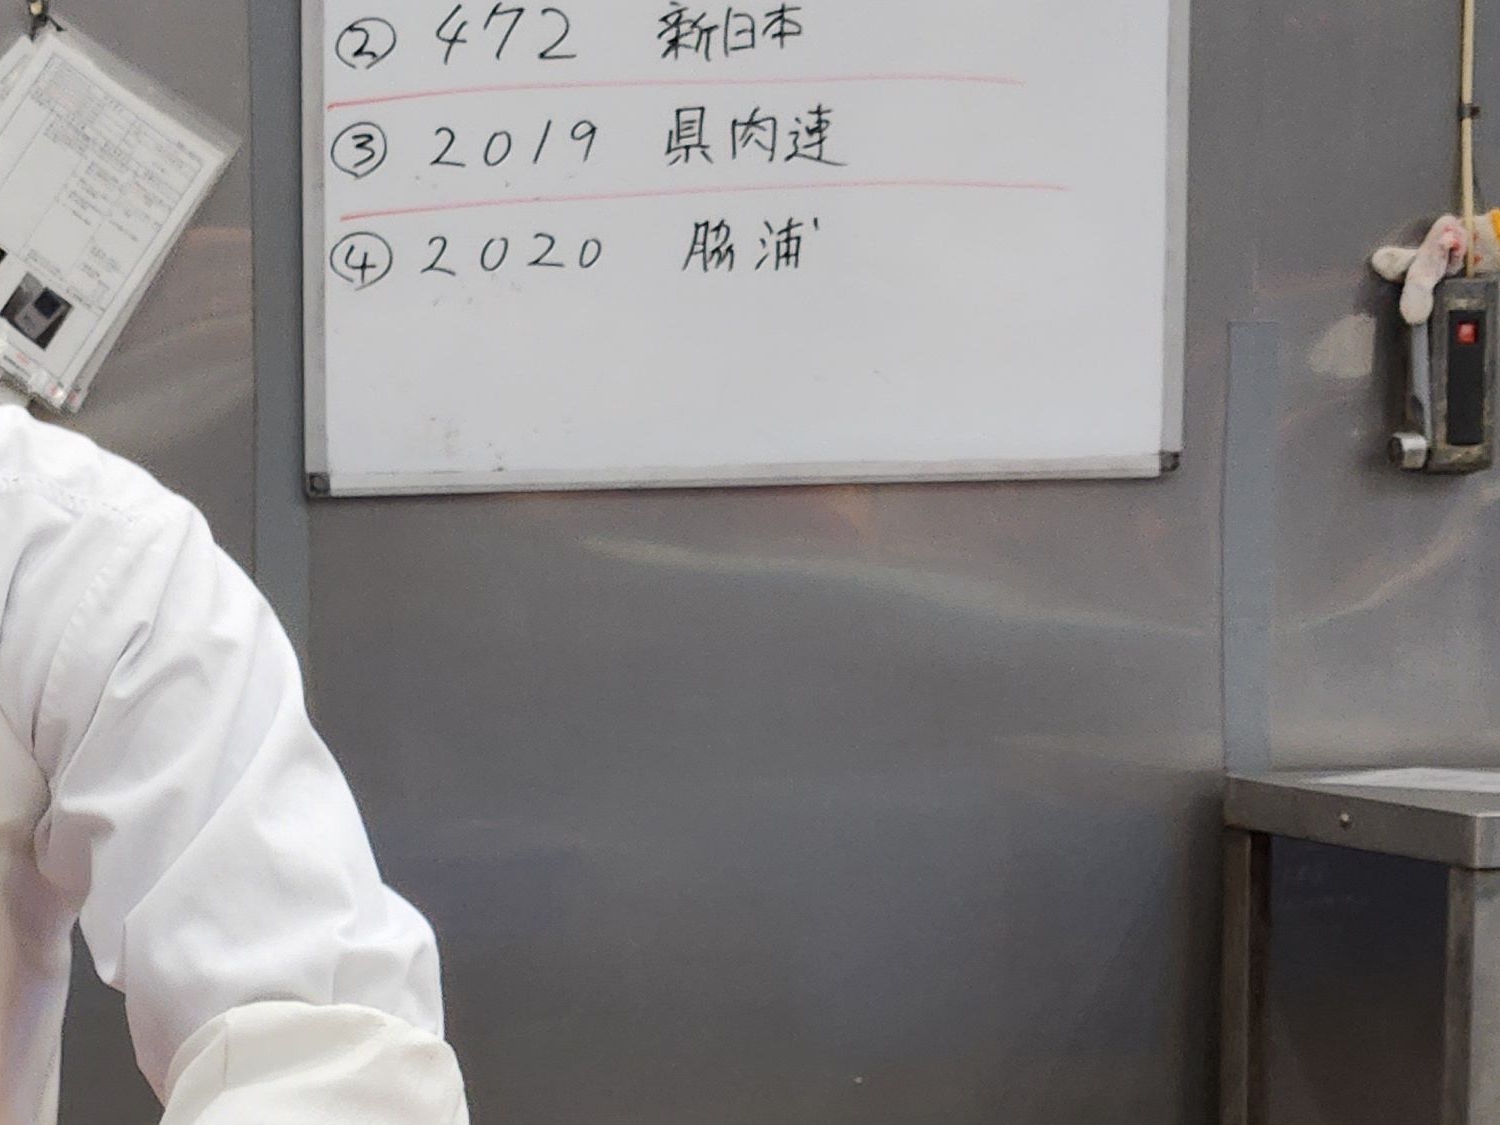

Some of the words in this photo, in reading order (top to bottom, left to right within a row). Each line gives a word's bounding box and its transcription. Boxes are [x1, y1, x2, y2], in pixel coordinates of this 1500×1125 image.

[436, 3, 577, 65] 472
[657, 2, 802, 62] 新日本
[430, 120, 598, 168] 2019
[665, 104, 847, 166] 県肉連
[420, 233, 602, 276] 2020
